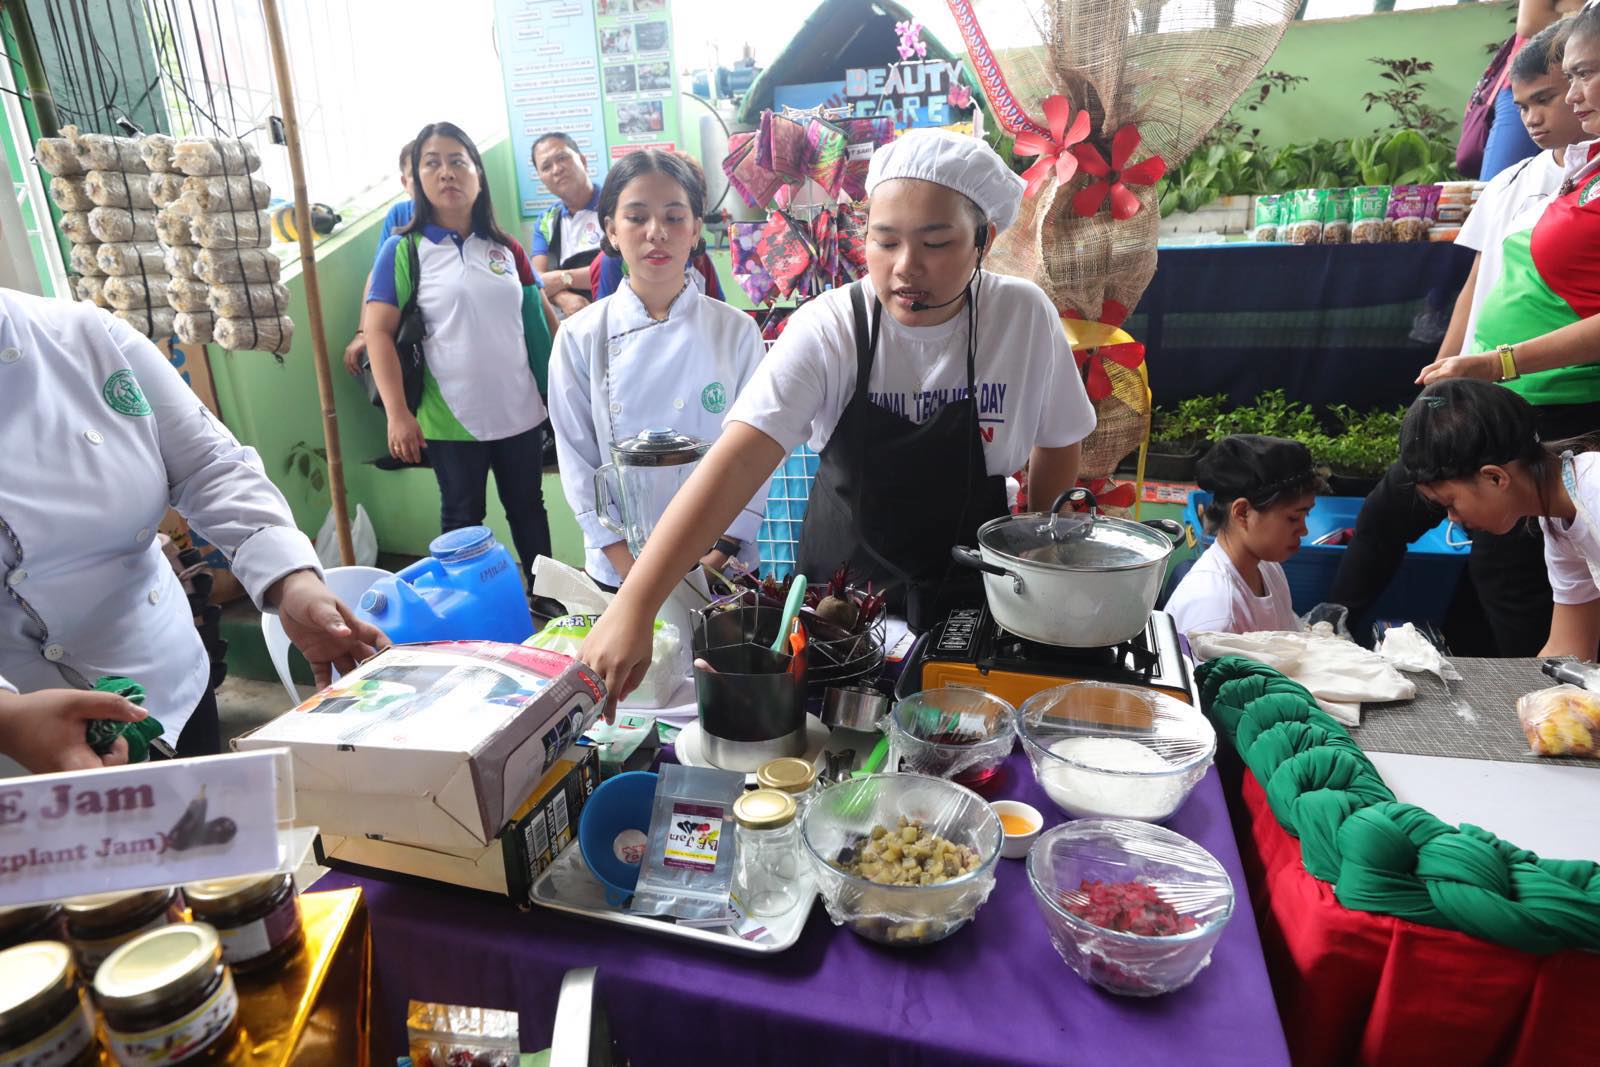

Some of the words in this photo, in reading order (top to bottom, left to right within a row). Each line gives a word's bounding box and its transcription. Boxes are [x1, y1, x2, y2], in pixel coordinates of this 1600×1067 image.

[846, 60, 964, 97] BEAUTY
[980, 383, 1007, 414] DAY
[41, 783, 156, 820] Jam
